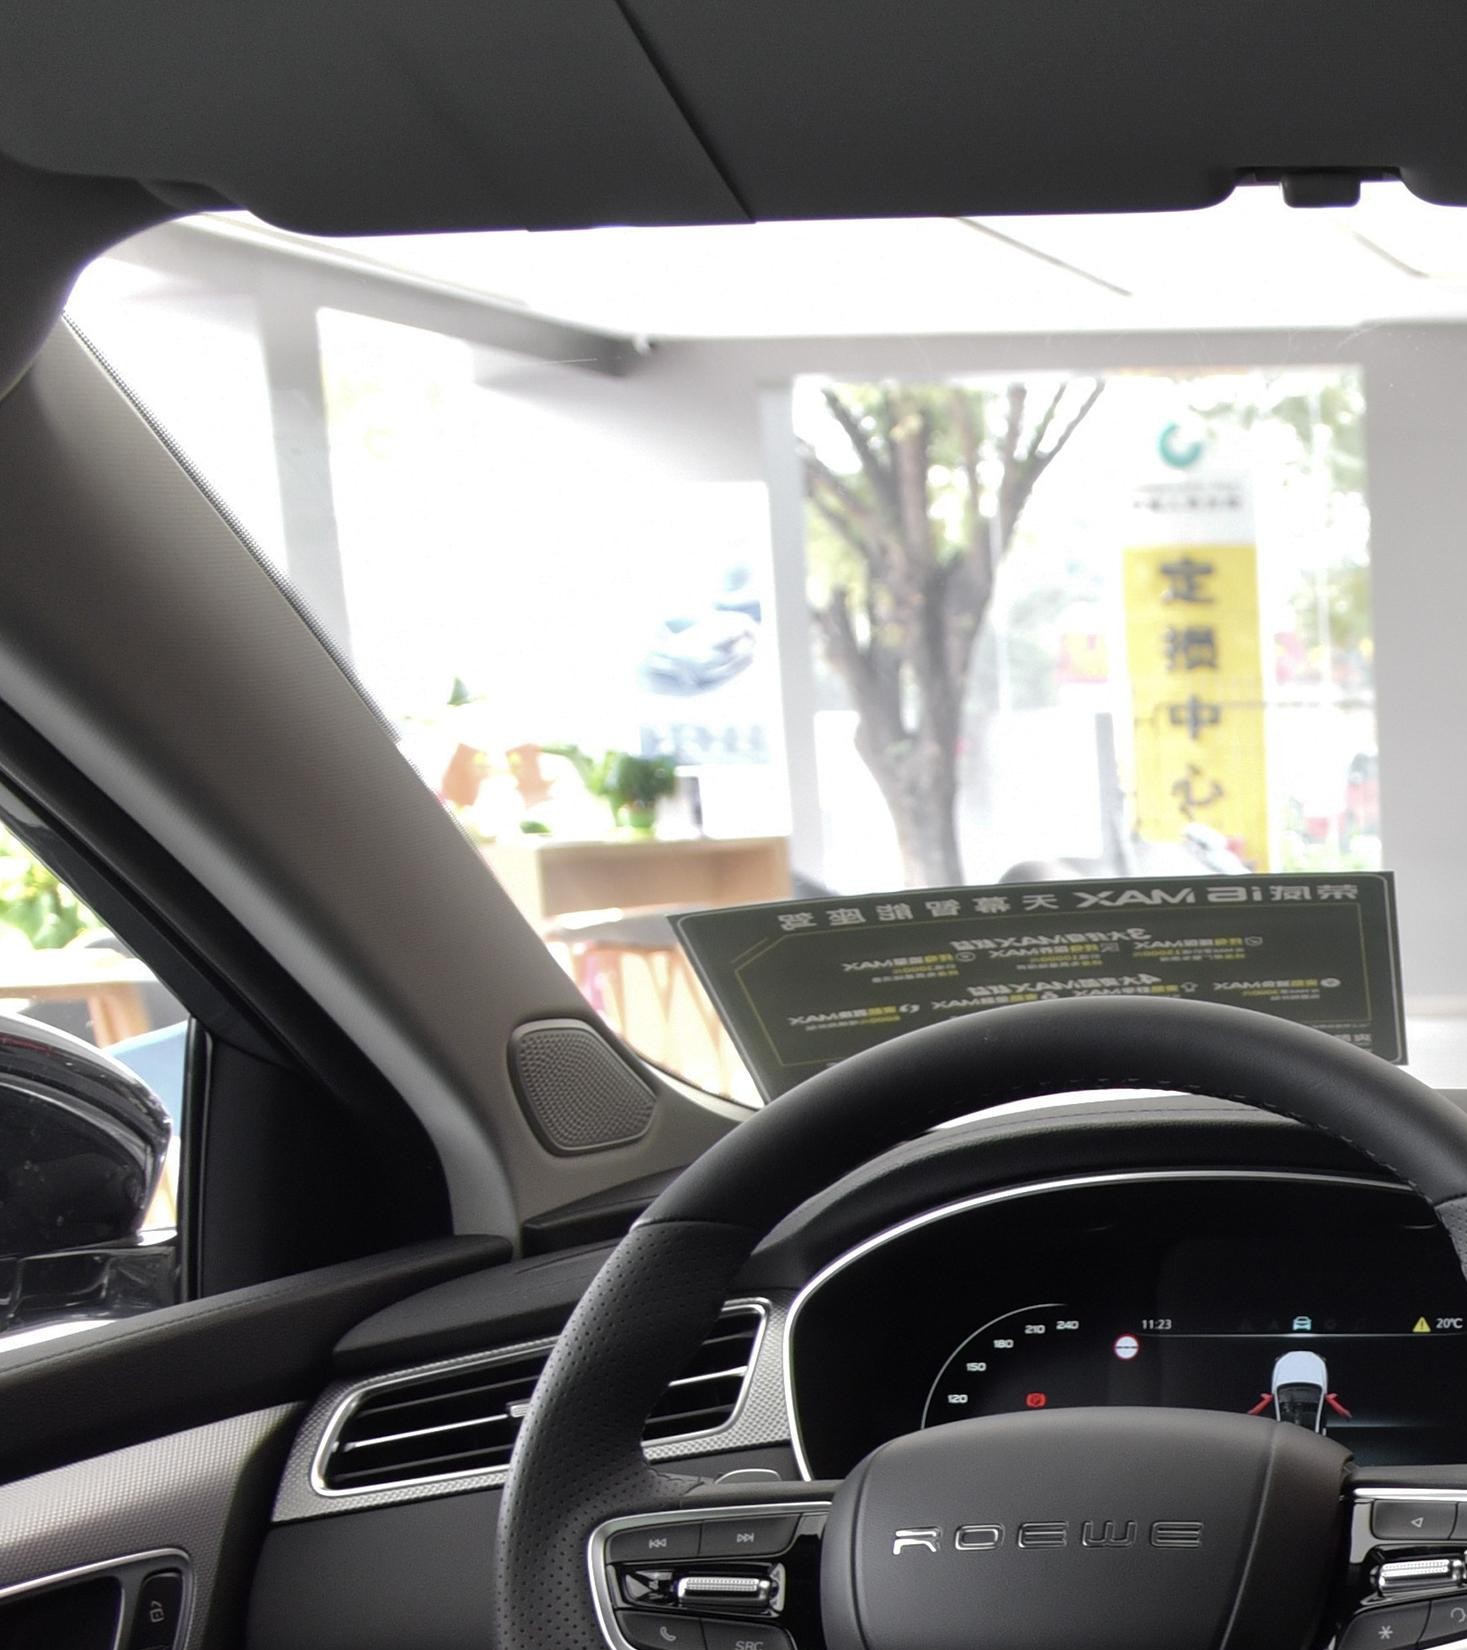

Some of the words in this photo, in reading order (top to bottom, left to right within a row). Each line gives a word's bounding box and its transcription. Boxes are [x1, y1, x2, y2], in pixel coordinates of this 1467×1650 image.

[1024, 1325, 1046, 1334] 210
[1056, 1320, 1079, 1330] 240
[1142, 1319, 1172, 1330] 11:23
[993, 1339, 1014, 1349] 180
[966, 1362, 987, 1372] 150
[947, 1394, 968, 1404] 120
[893, 1520, 1204, 1555] ROEWE
